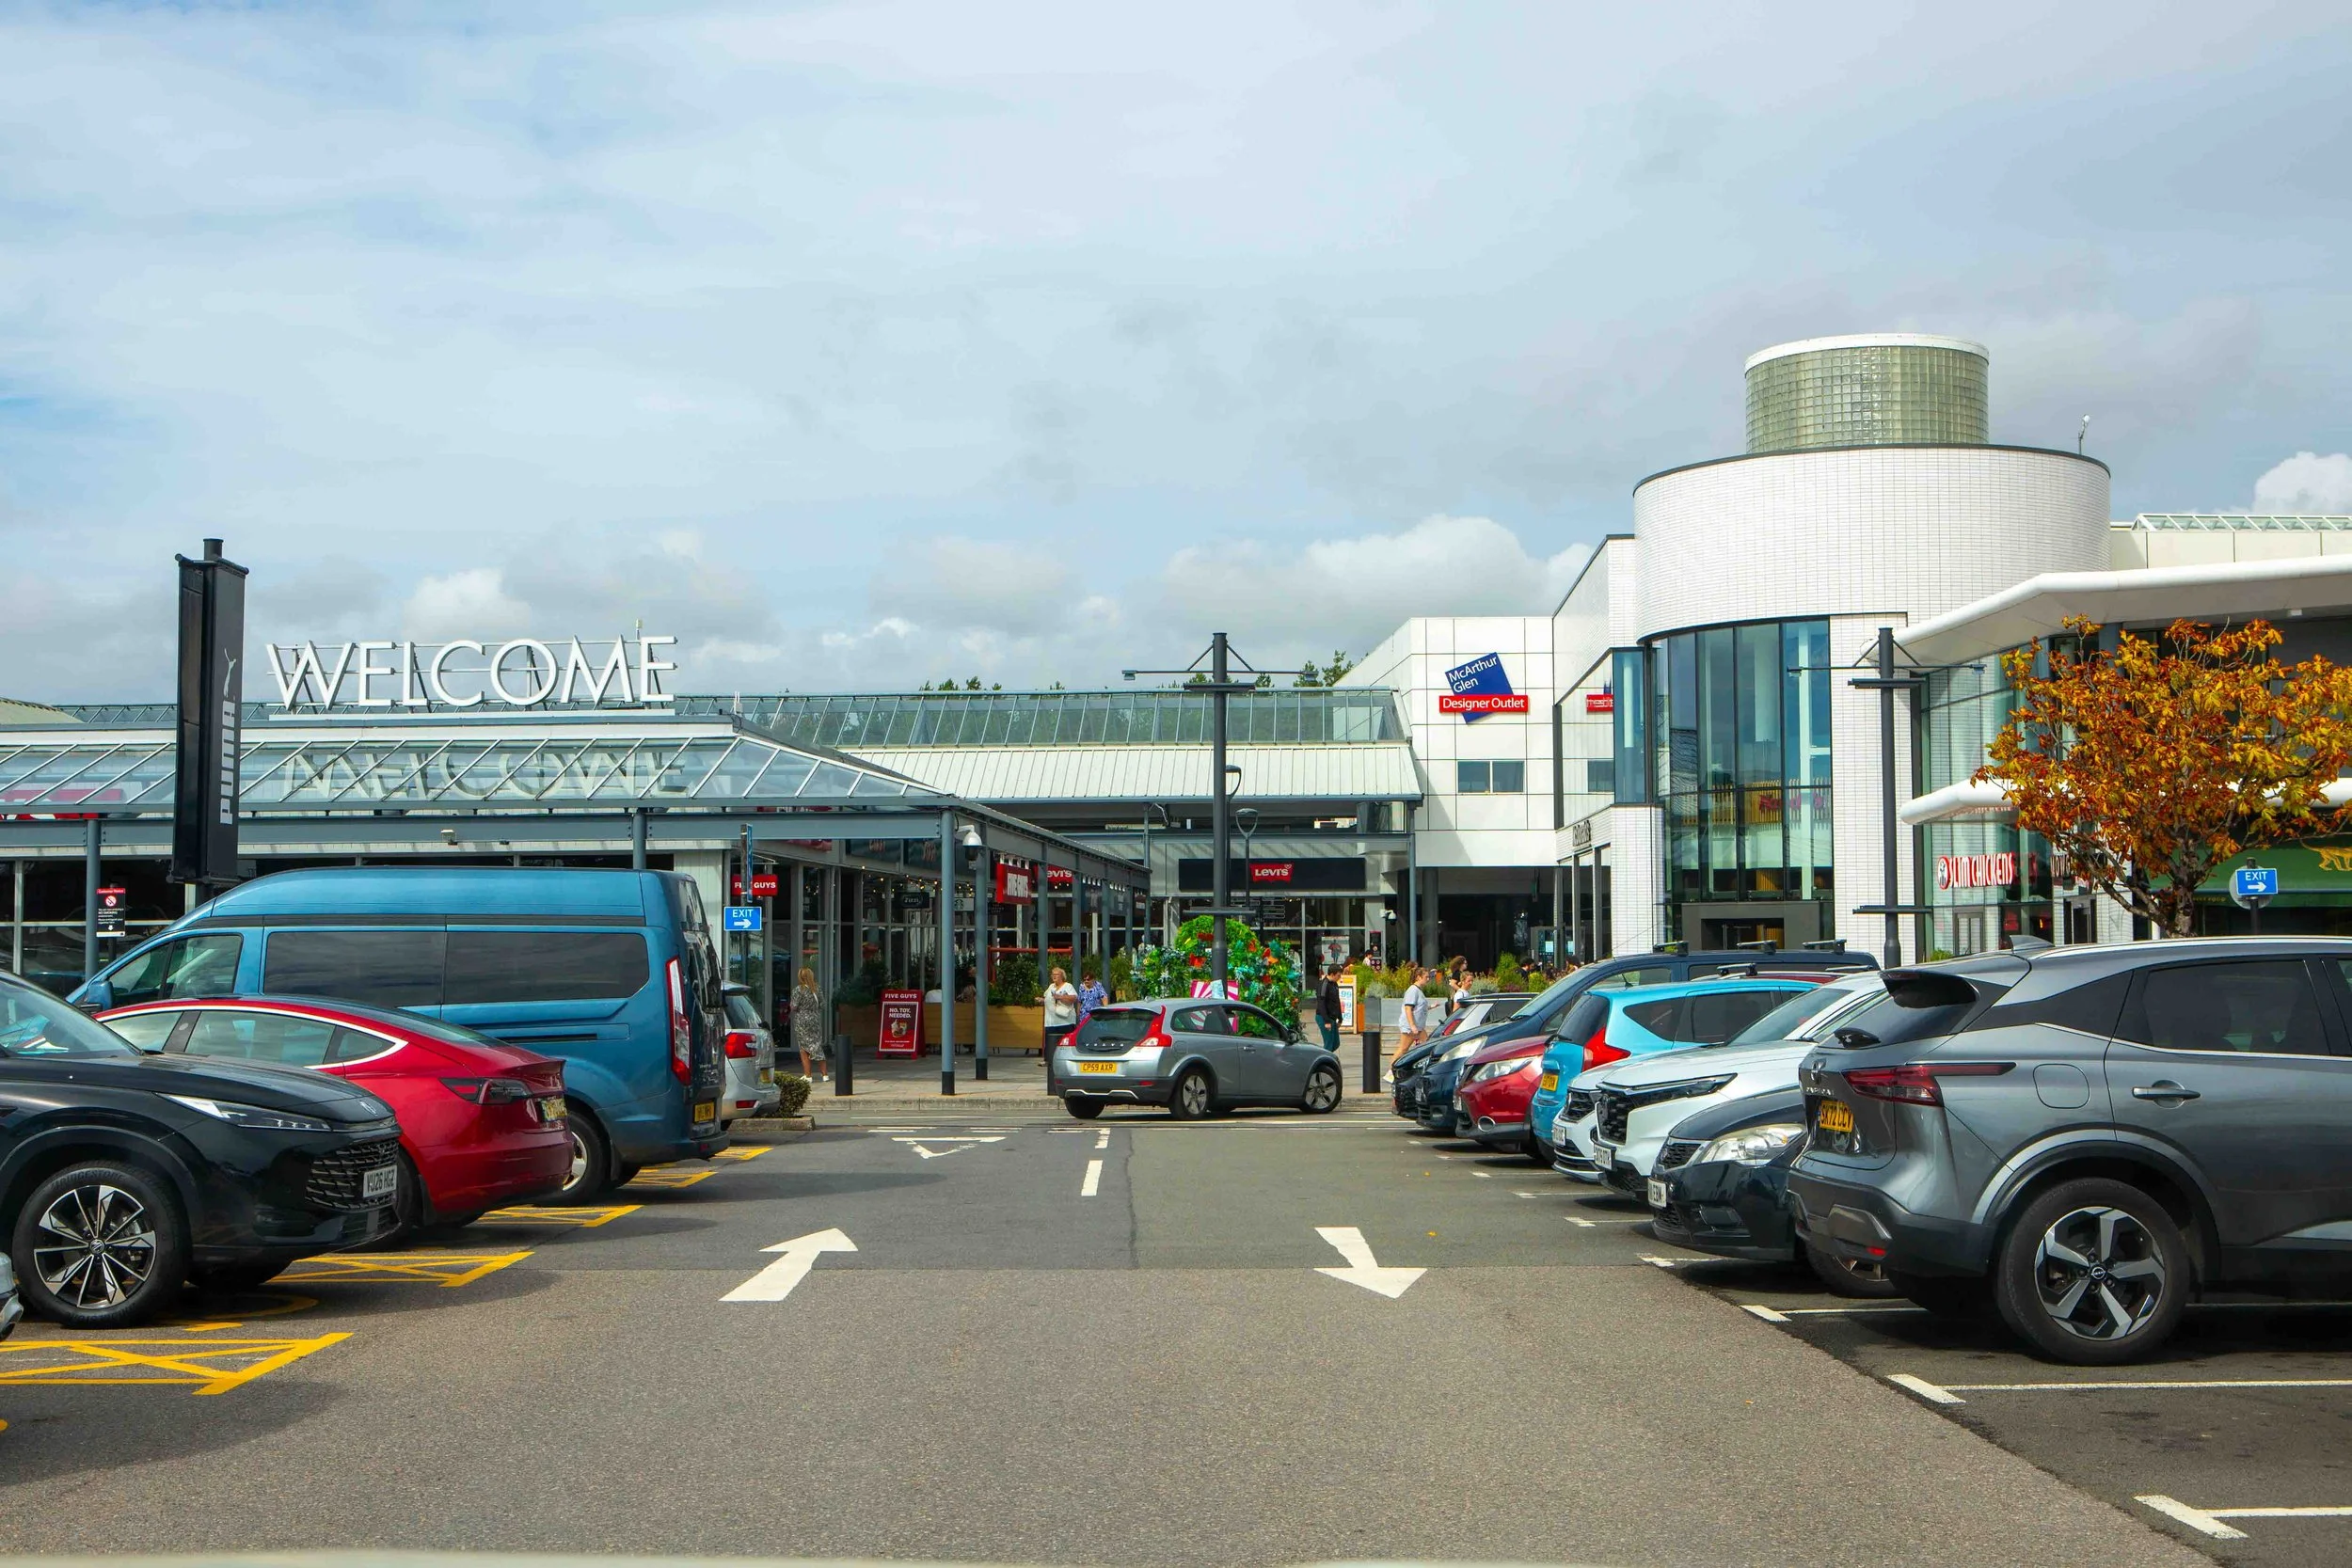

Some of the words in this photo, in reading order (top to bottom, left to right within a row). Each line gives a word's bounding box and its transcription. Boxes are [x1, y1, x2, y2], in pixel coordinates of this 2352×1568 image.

[266, 634, 677, 711] WELCOME
[1448, 656, 1498, 683] McArthur
[1453, 676, 1479, 693] Glen
[1442, 697, 1490, 711] Designer
[1491, 697, 1524, 709] Outlet
[219, 700, 235, 825] PUMA
[1047, 869, 1073, 878] evi's
[1949, 856, 1971, 888] SLIM
[1971, 852, 2013, 887] CHICKENS
[2245, 871, 2267, 881] EXIT
[732, 909, 754, 918] EXIT
[1083, 1063, 1099, 1071] CP59
[1100, 1063, 1113, 1071] AXR
